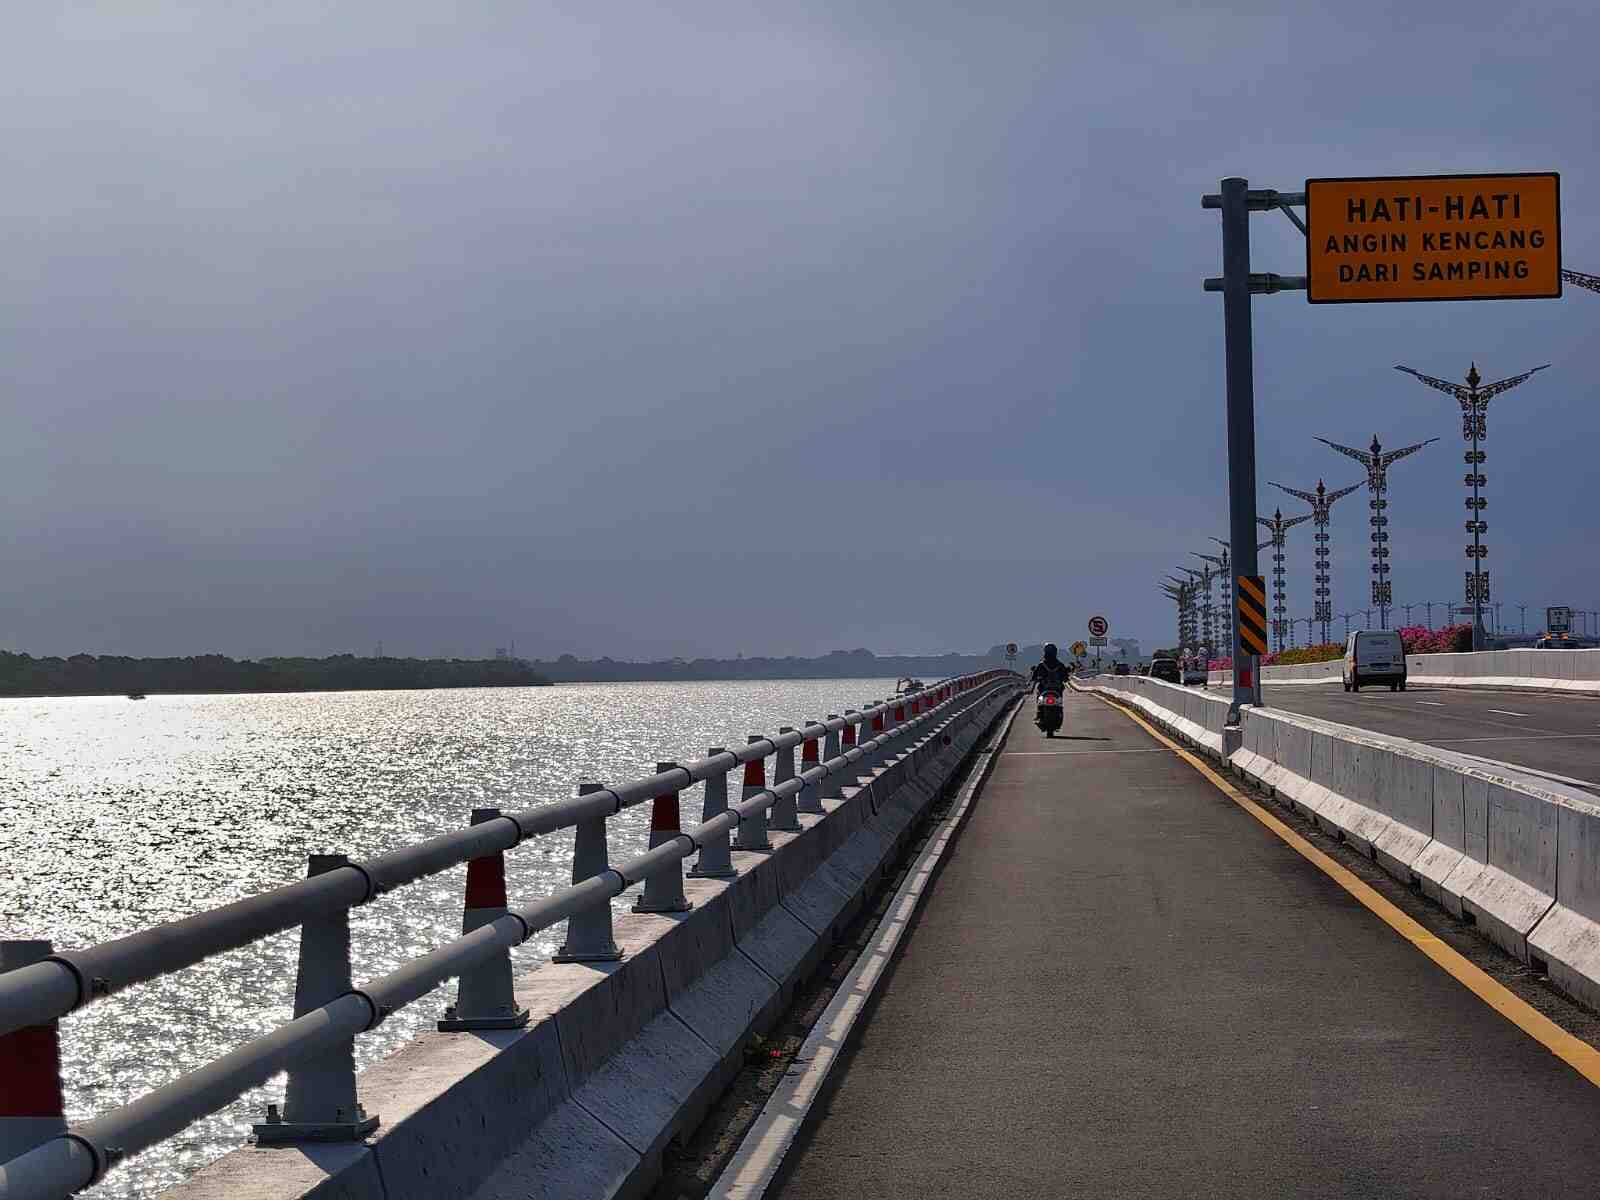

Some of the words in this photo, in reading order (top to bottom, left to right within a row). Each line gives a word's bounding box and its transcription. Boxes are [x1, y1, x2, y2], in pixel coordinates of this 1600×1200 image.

[1347, 194, 1521, 222] HATI-HATI
[1325, 234, 1407, 253] ANGIN
[1422, 230, 1544, 251] KENCANG
[1339, 263, 1398, 282] DARI
[1412, 260, 1529, 281] SAMPING
